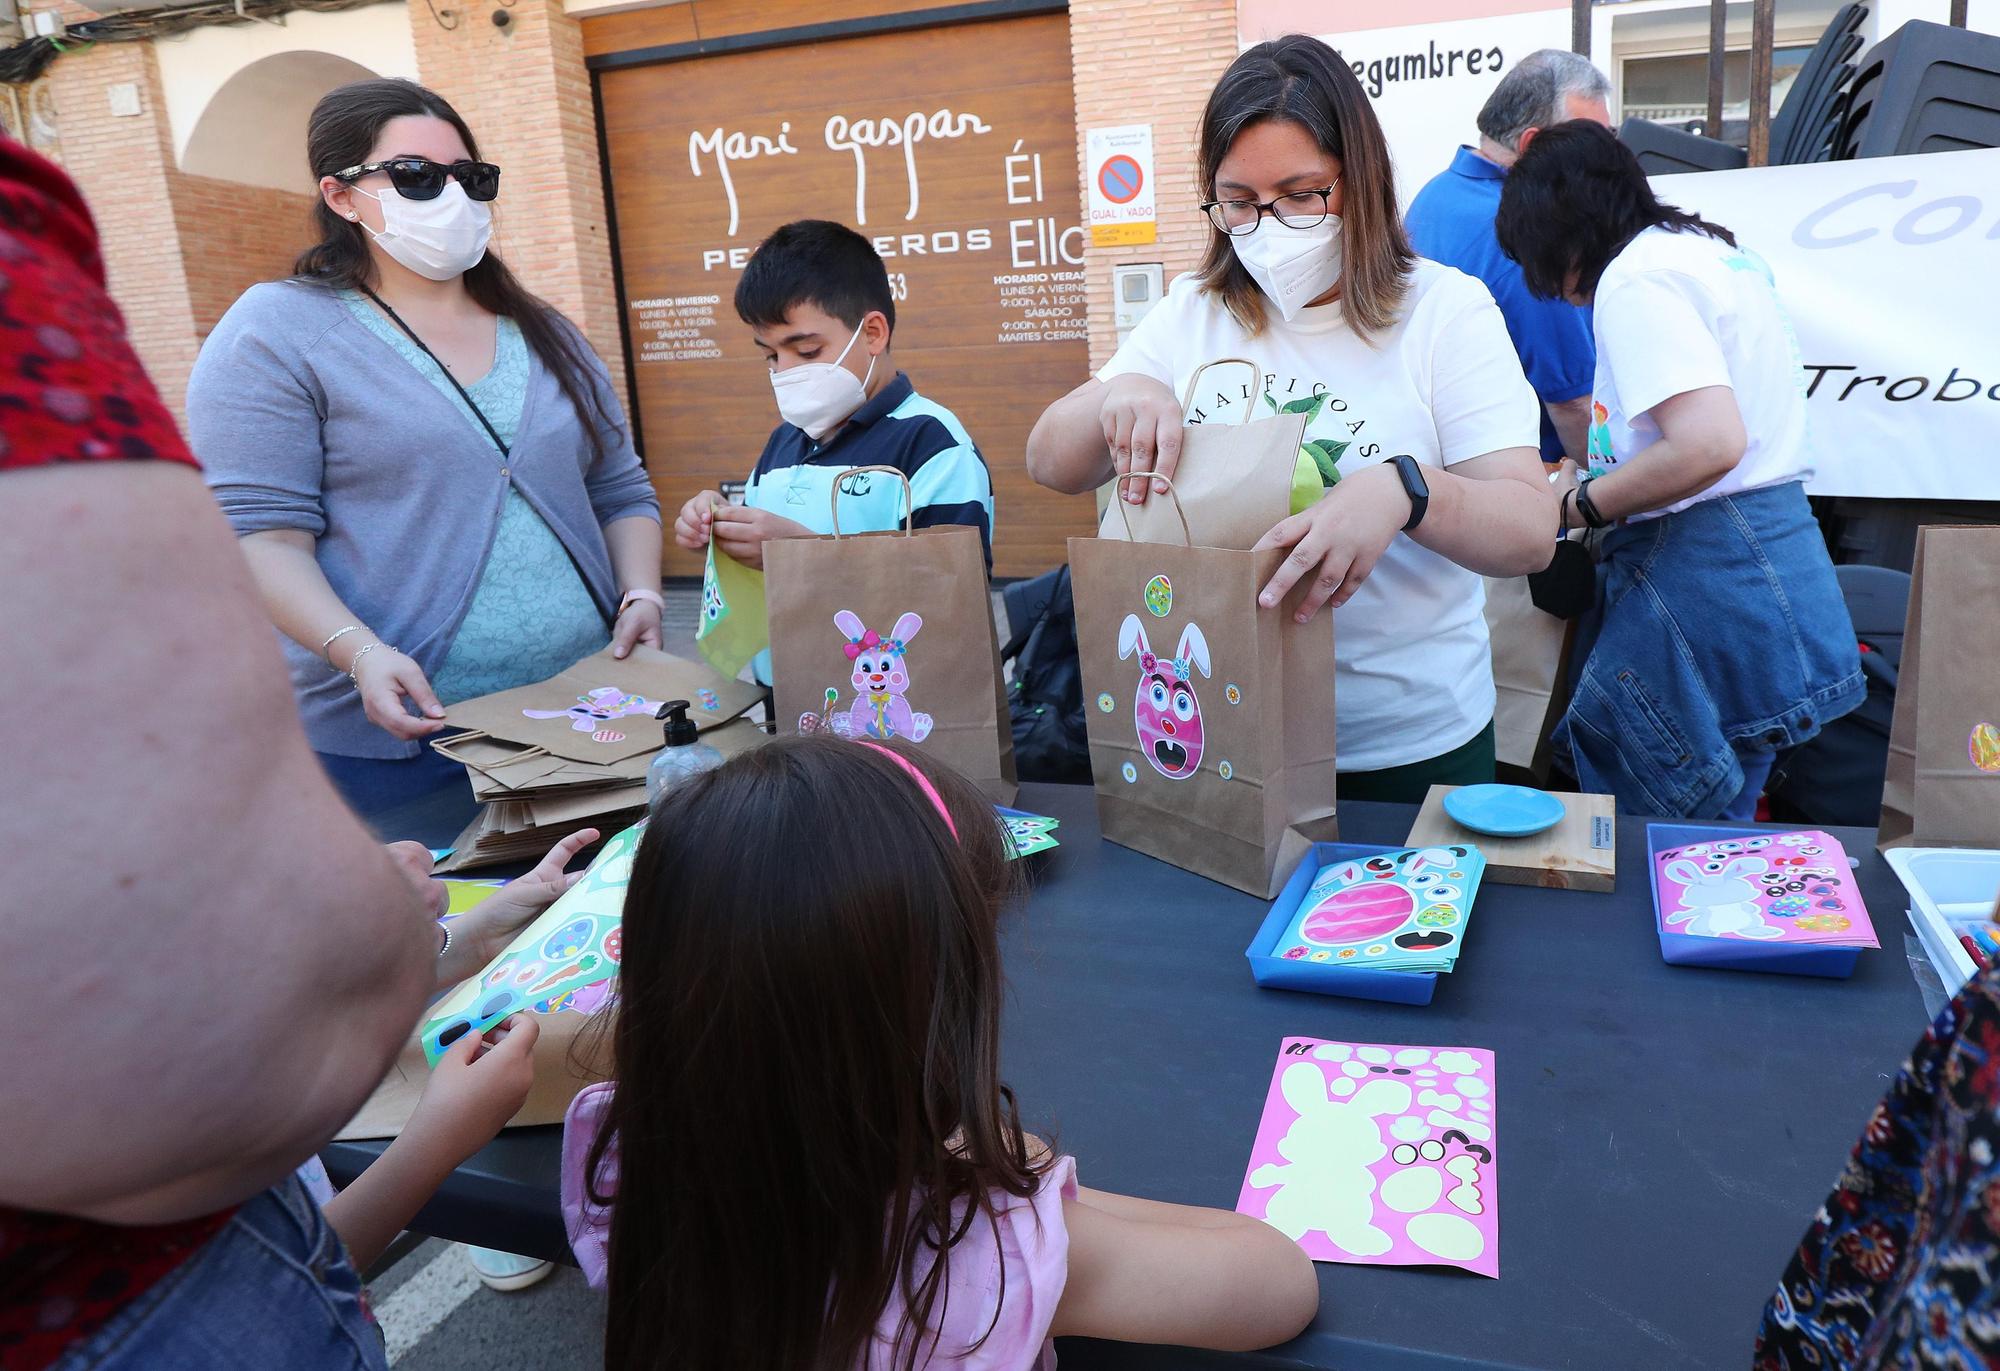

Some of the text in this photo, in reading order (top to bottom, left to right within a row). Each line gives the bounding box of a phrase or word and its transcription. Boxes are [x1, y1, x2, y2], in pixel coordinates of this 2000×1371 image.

[1350, 40, 1503, 98] egumbres
[689, 108, 992, 236] Mari Gaspar
[1004, 139, 1044, 204] Él
[1091, 209, 1117, 220] GUAL
[1126, 206, 1153, 217] VADO
[993, 273, 1048, 285] HORARIO
[1000, 285, 1035, 296] LUNES
[1037, 285, 1046, 294] A
[631, 295, 720, 310] HORARIO INVIERNO
[1040, 296, 1049, 305] A
[640, 308, 667, 319] LUNES
[1041, 319, 1050, 329] A
[998, 331, 1041, 342] MARTES
